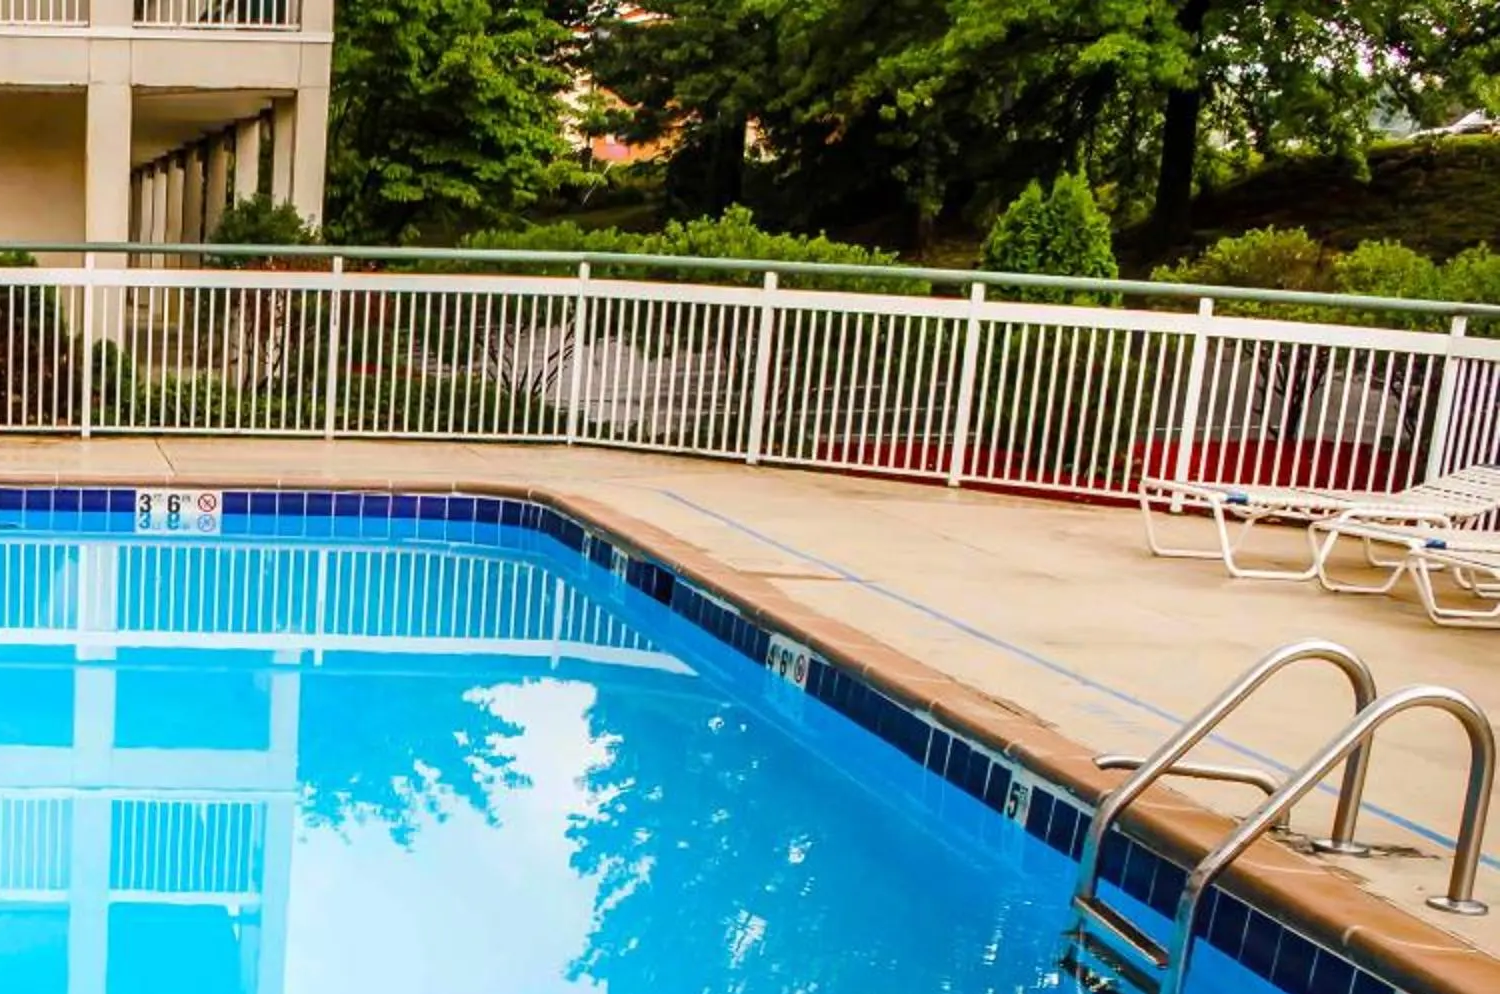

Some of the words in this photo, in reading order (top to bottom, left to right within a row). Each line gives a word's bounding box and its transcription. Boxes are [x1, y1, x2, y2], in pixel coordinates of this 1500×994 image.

[139, 493, 152, 513] 3
[167, 493, 180, 514] 6
[1007, 781, 1020, 820] 5
